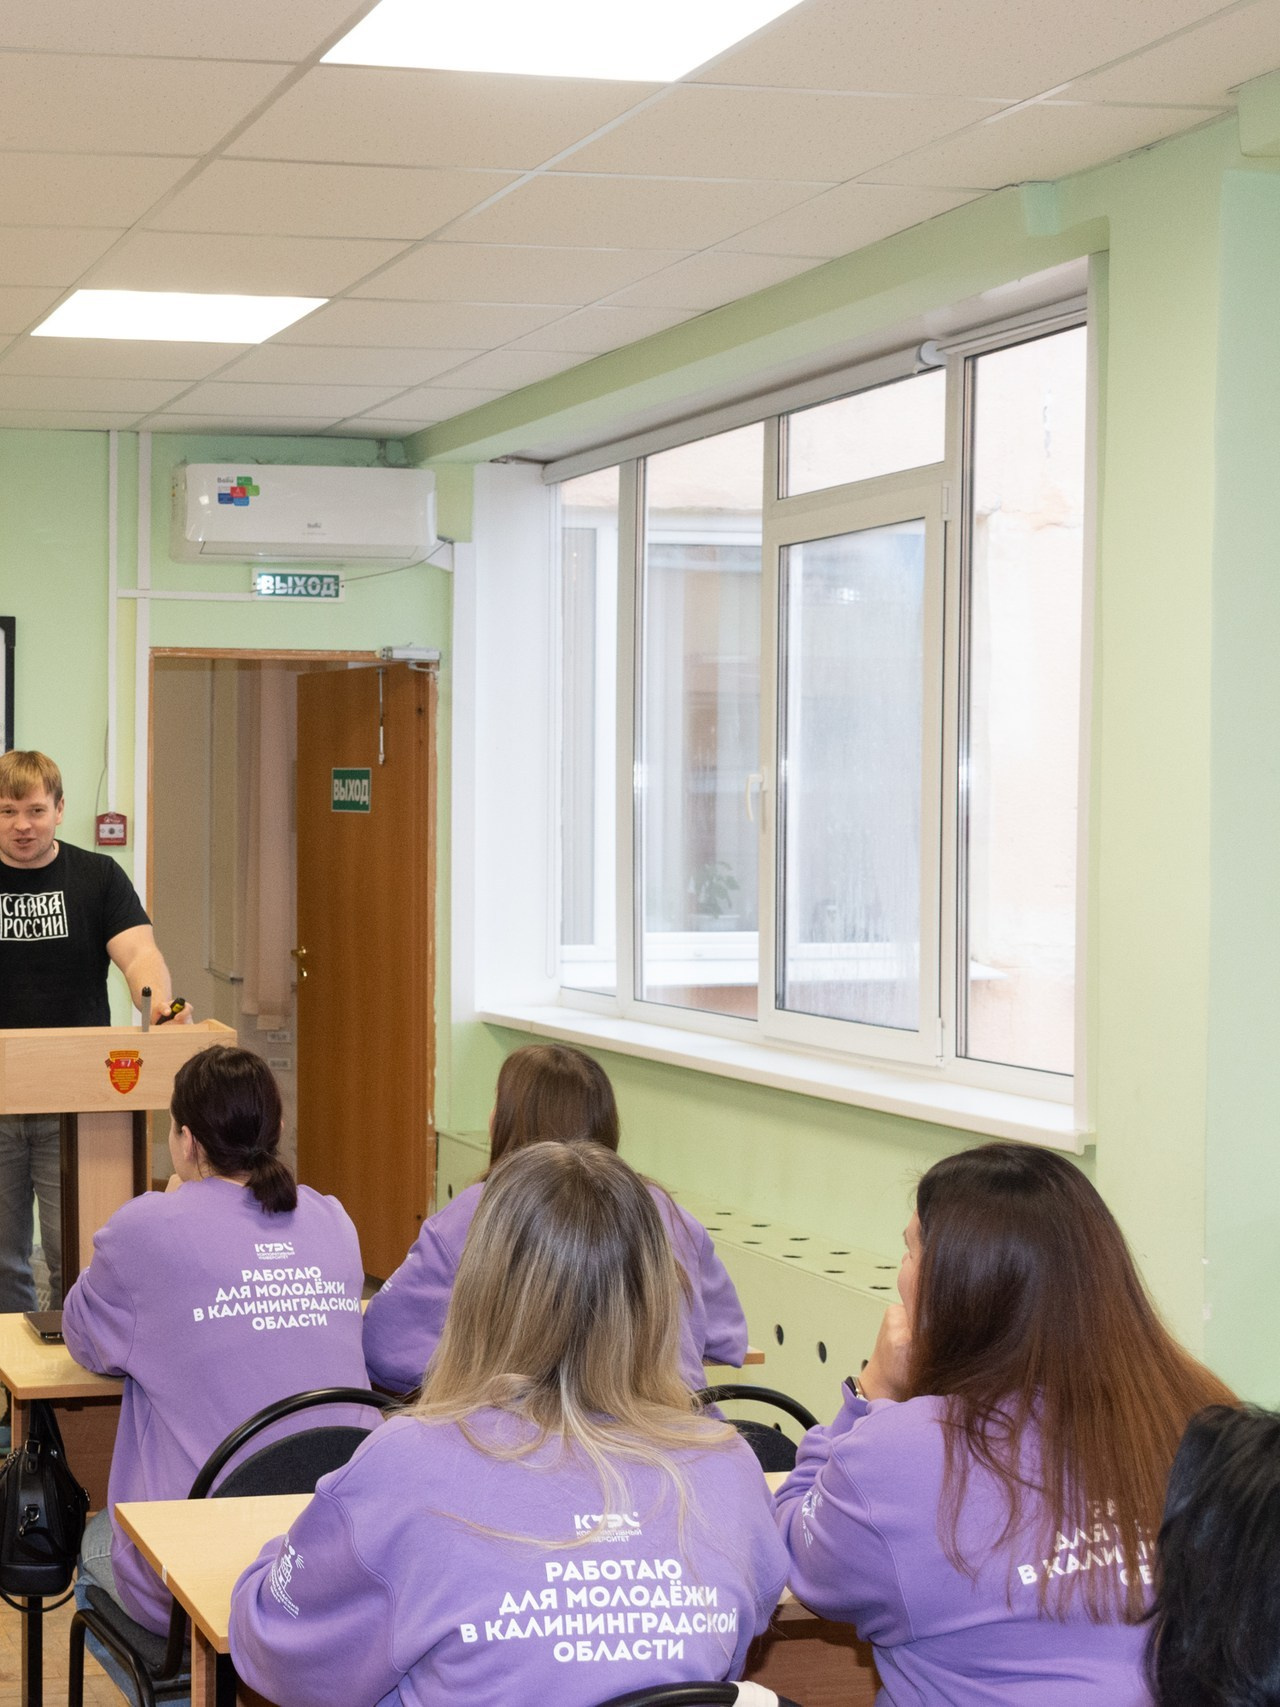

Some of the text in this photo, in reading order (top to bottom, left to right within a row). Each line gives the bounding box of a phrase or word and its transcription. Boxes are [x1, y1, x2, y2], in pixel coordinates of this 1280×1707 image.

[261, 575, 336, 597] ВЫХОД
[333, 778, 369, 805] ВЫХОД
[2, 893, 62, 917] СЛАВА
[3, 914, 64, 938] РОССИИ
[241, 1266, 322, 1283] РАБОТАЮ
[215, 1279, 345, 1303] ДЛЯ МОЛОДЁЖИ
[193, 1297, 360, 1322] В КАЛИНИНГРАДСКОЙ
[252, 1313, 328, 1331] ОБЛАСТИ
[545, 1559, 682, 1582] РАБОТАЮ
[1017, 1564, 1038, 1585] В
[499, 1580, 718, 1615] ДЛЯ МОЛОДЁЖИ
[460, 1608, 739, 1643] В КАЛИНИНГРАДСКОЙ
[553, 1639, 684, 1662] ОБЛАСТИ
